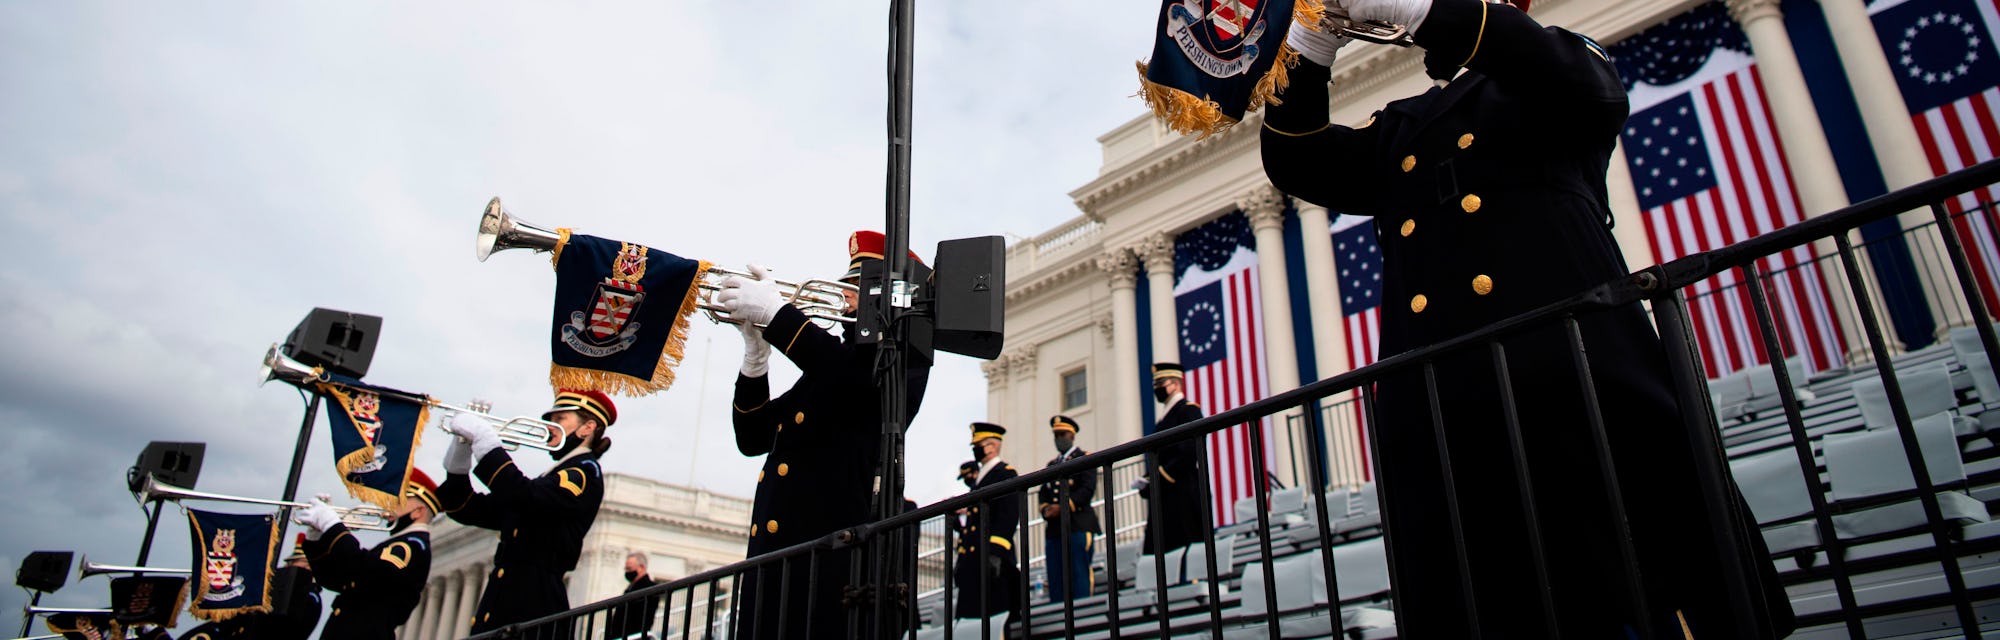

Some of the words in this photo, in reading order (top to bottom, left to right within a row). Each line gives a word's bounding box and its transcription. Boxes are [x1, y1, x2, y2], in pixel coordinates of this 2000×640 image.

[1177, 26, 1223, 75] PERSHING'S
[1224, 59, 1243, 76] OWN
[567, 334, 605, 356] PERSHING'S
